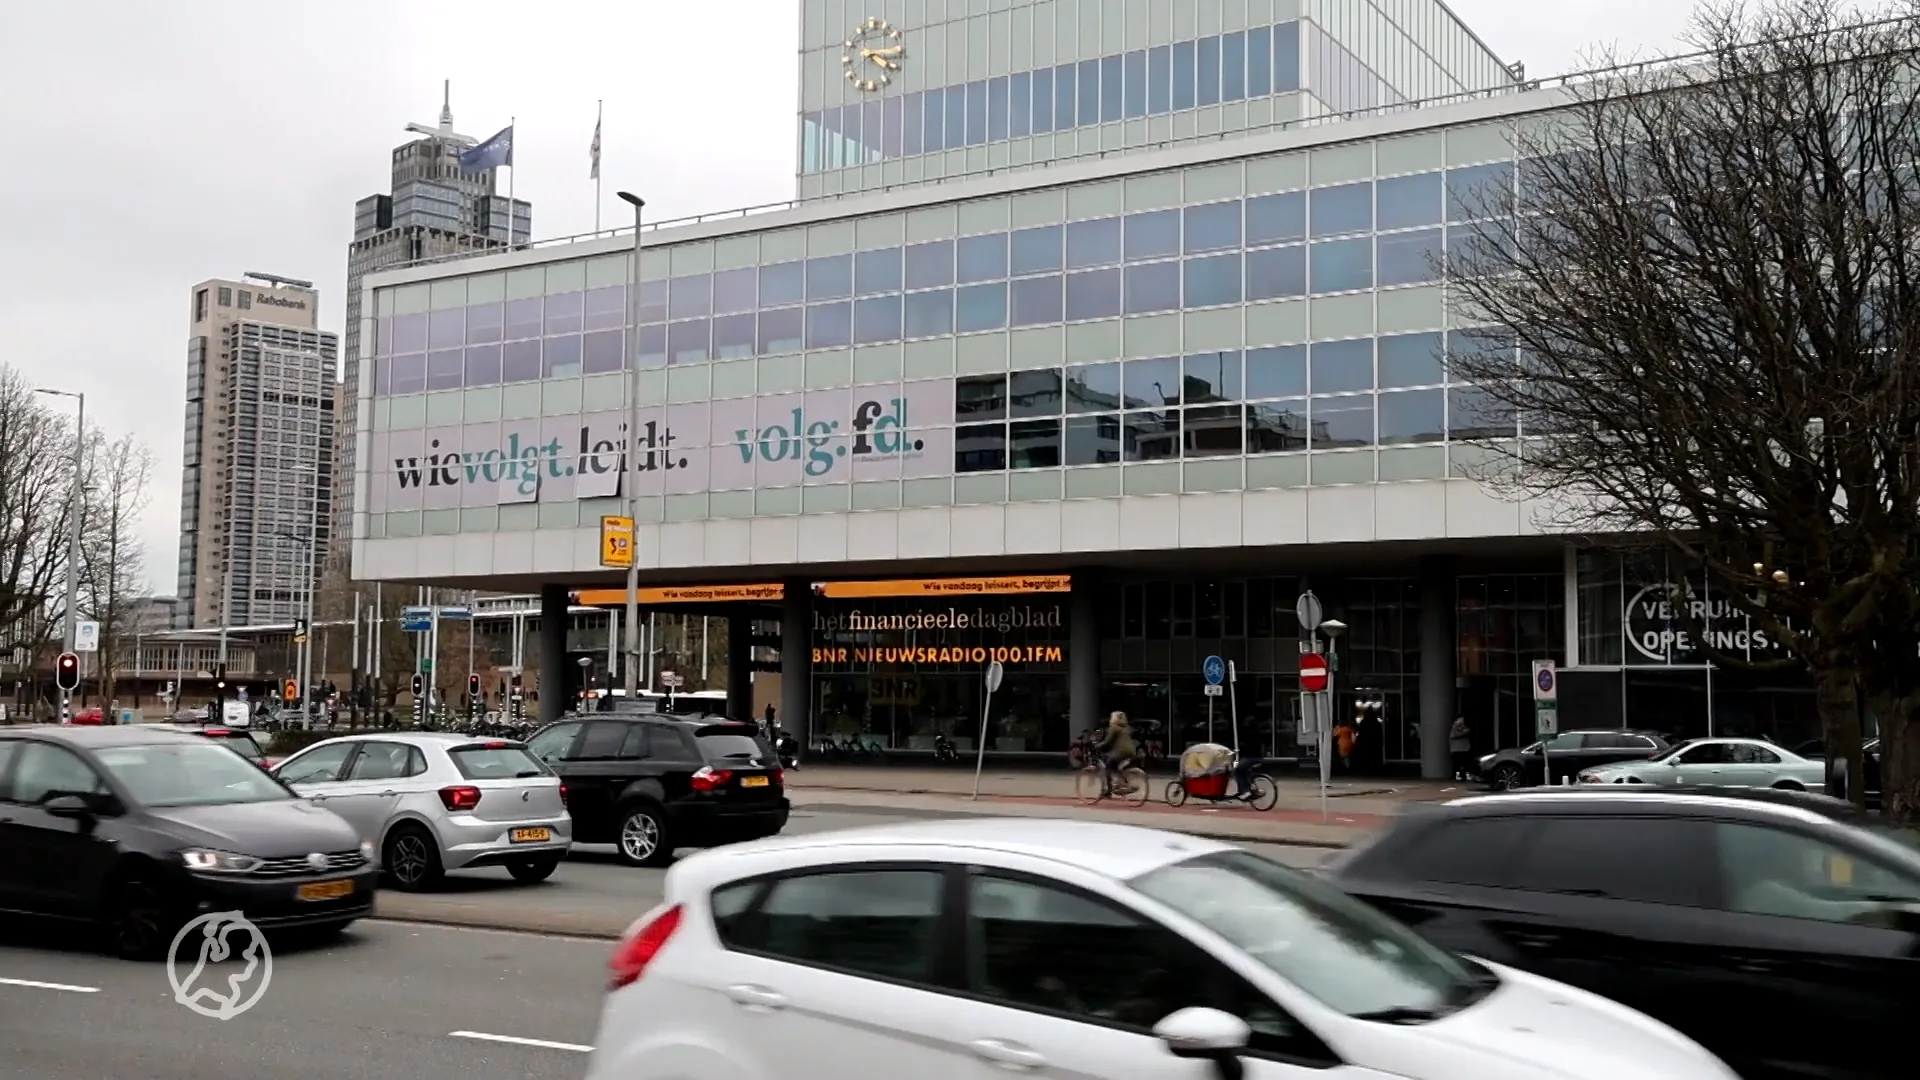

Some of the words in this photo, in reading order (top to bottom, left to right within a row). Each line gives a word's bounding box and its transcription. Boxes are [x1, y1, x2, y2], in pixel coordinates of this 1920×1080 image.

[256, 293, 306, 309] Rabobank
[663, 590, 678, 598] Wie
[812, 647, 848, 663] BNR
